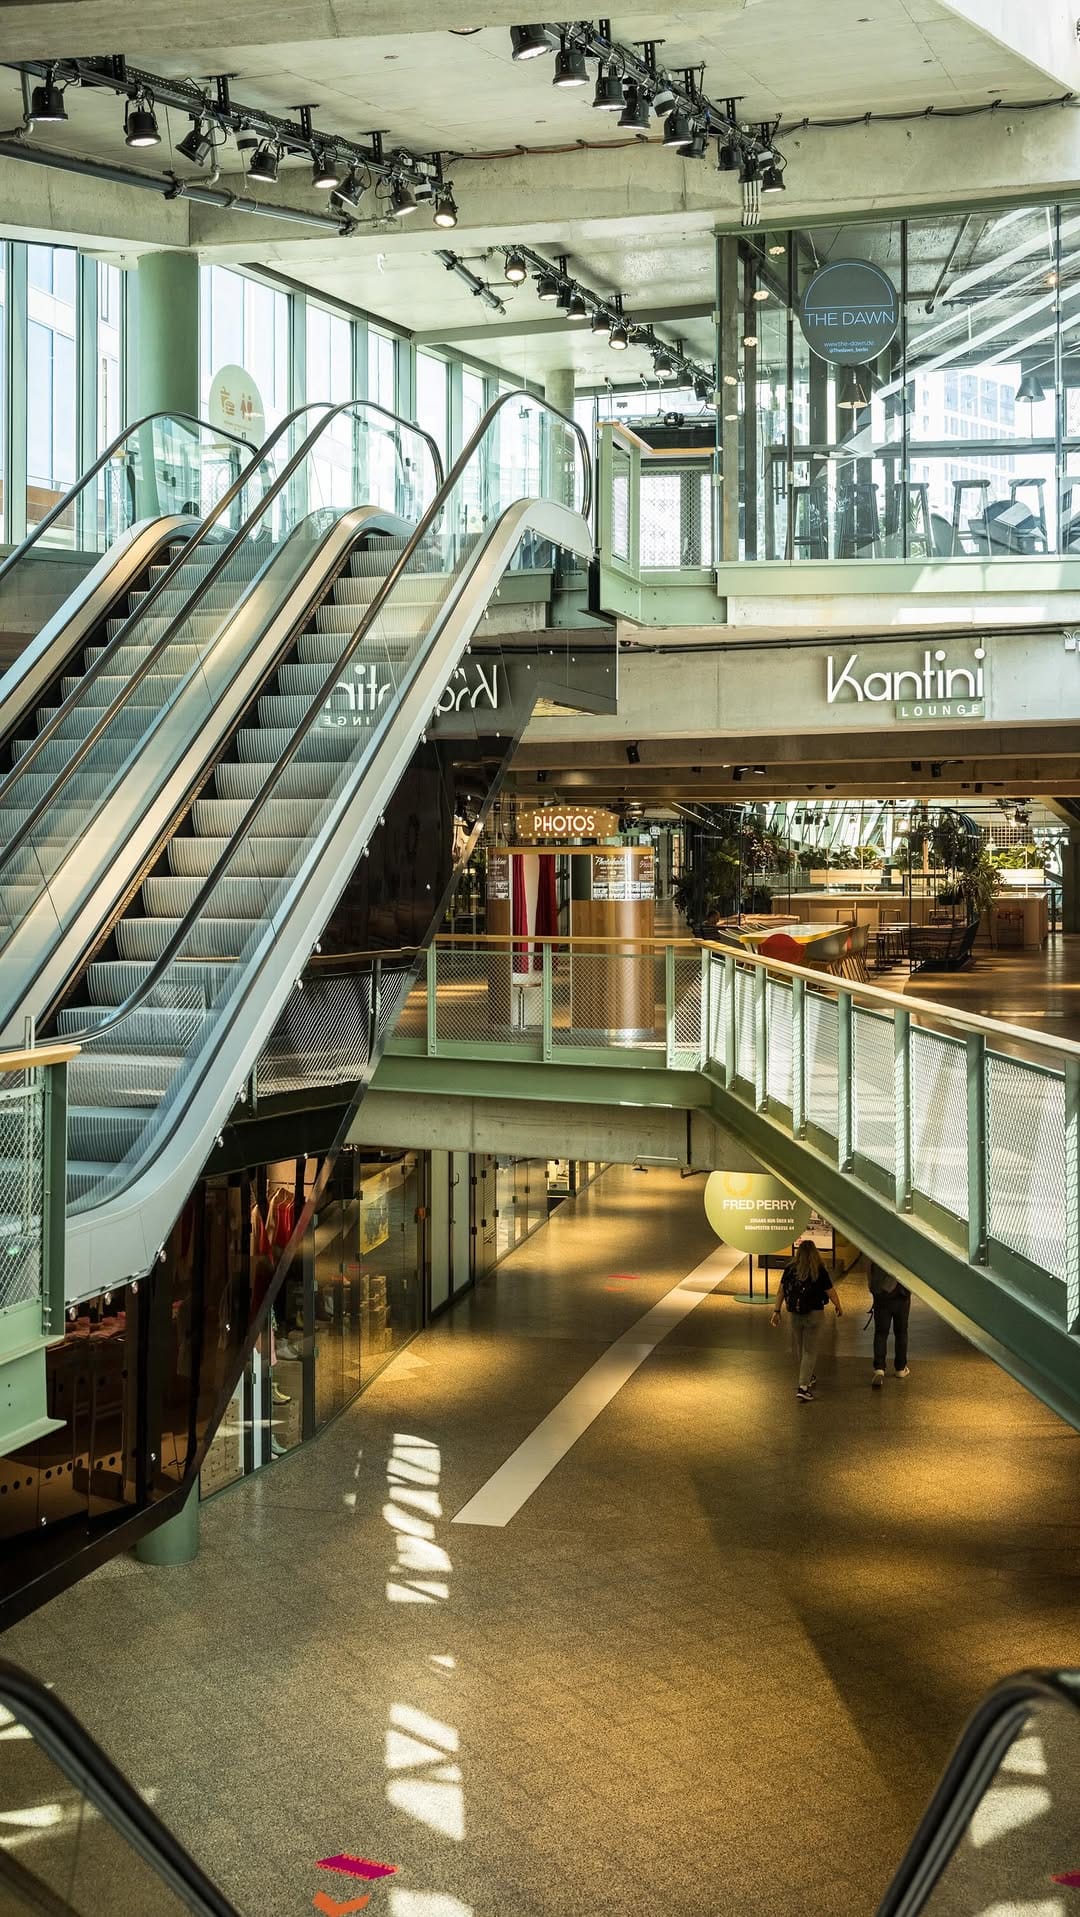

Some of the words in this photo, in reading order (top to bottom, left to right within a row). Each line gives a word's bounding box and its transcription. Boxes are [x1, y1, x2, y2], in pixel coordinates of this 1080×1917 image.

[804, 312, 838, 327] THE
[842, 311, 895, 326] DAWN
[827, 648, 985, 703] Kantini
[901, 704, 980, 717] LOUNGE
[534, 815, 595, 832] PHOTOS
[722, 1199, 755, 1211] FRED
[756, 1199, 798, 1211] PERRY
